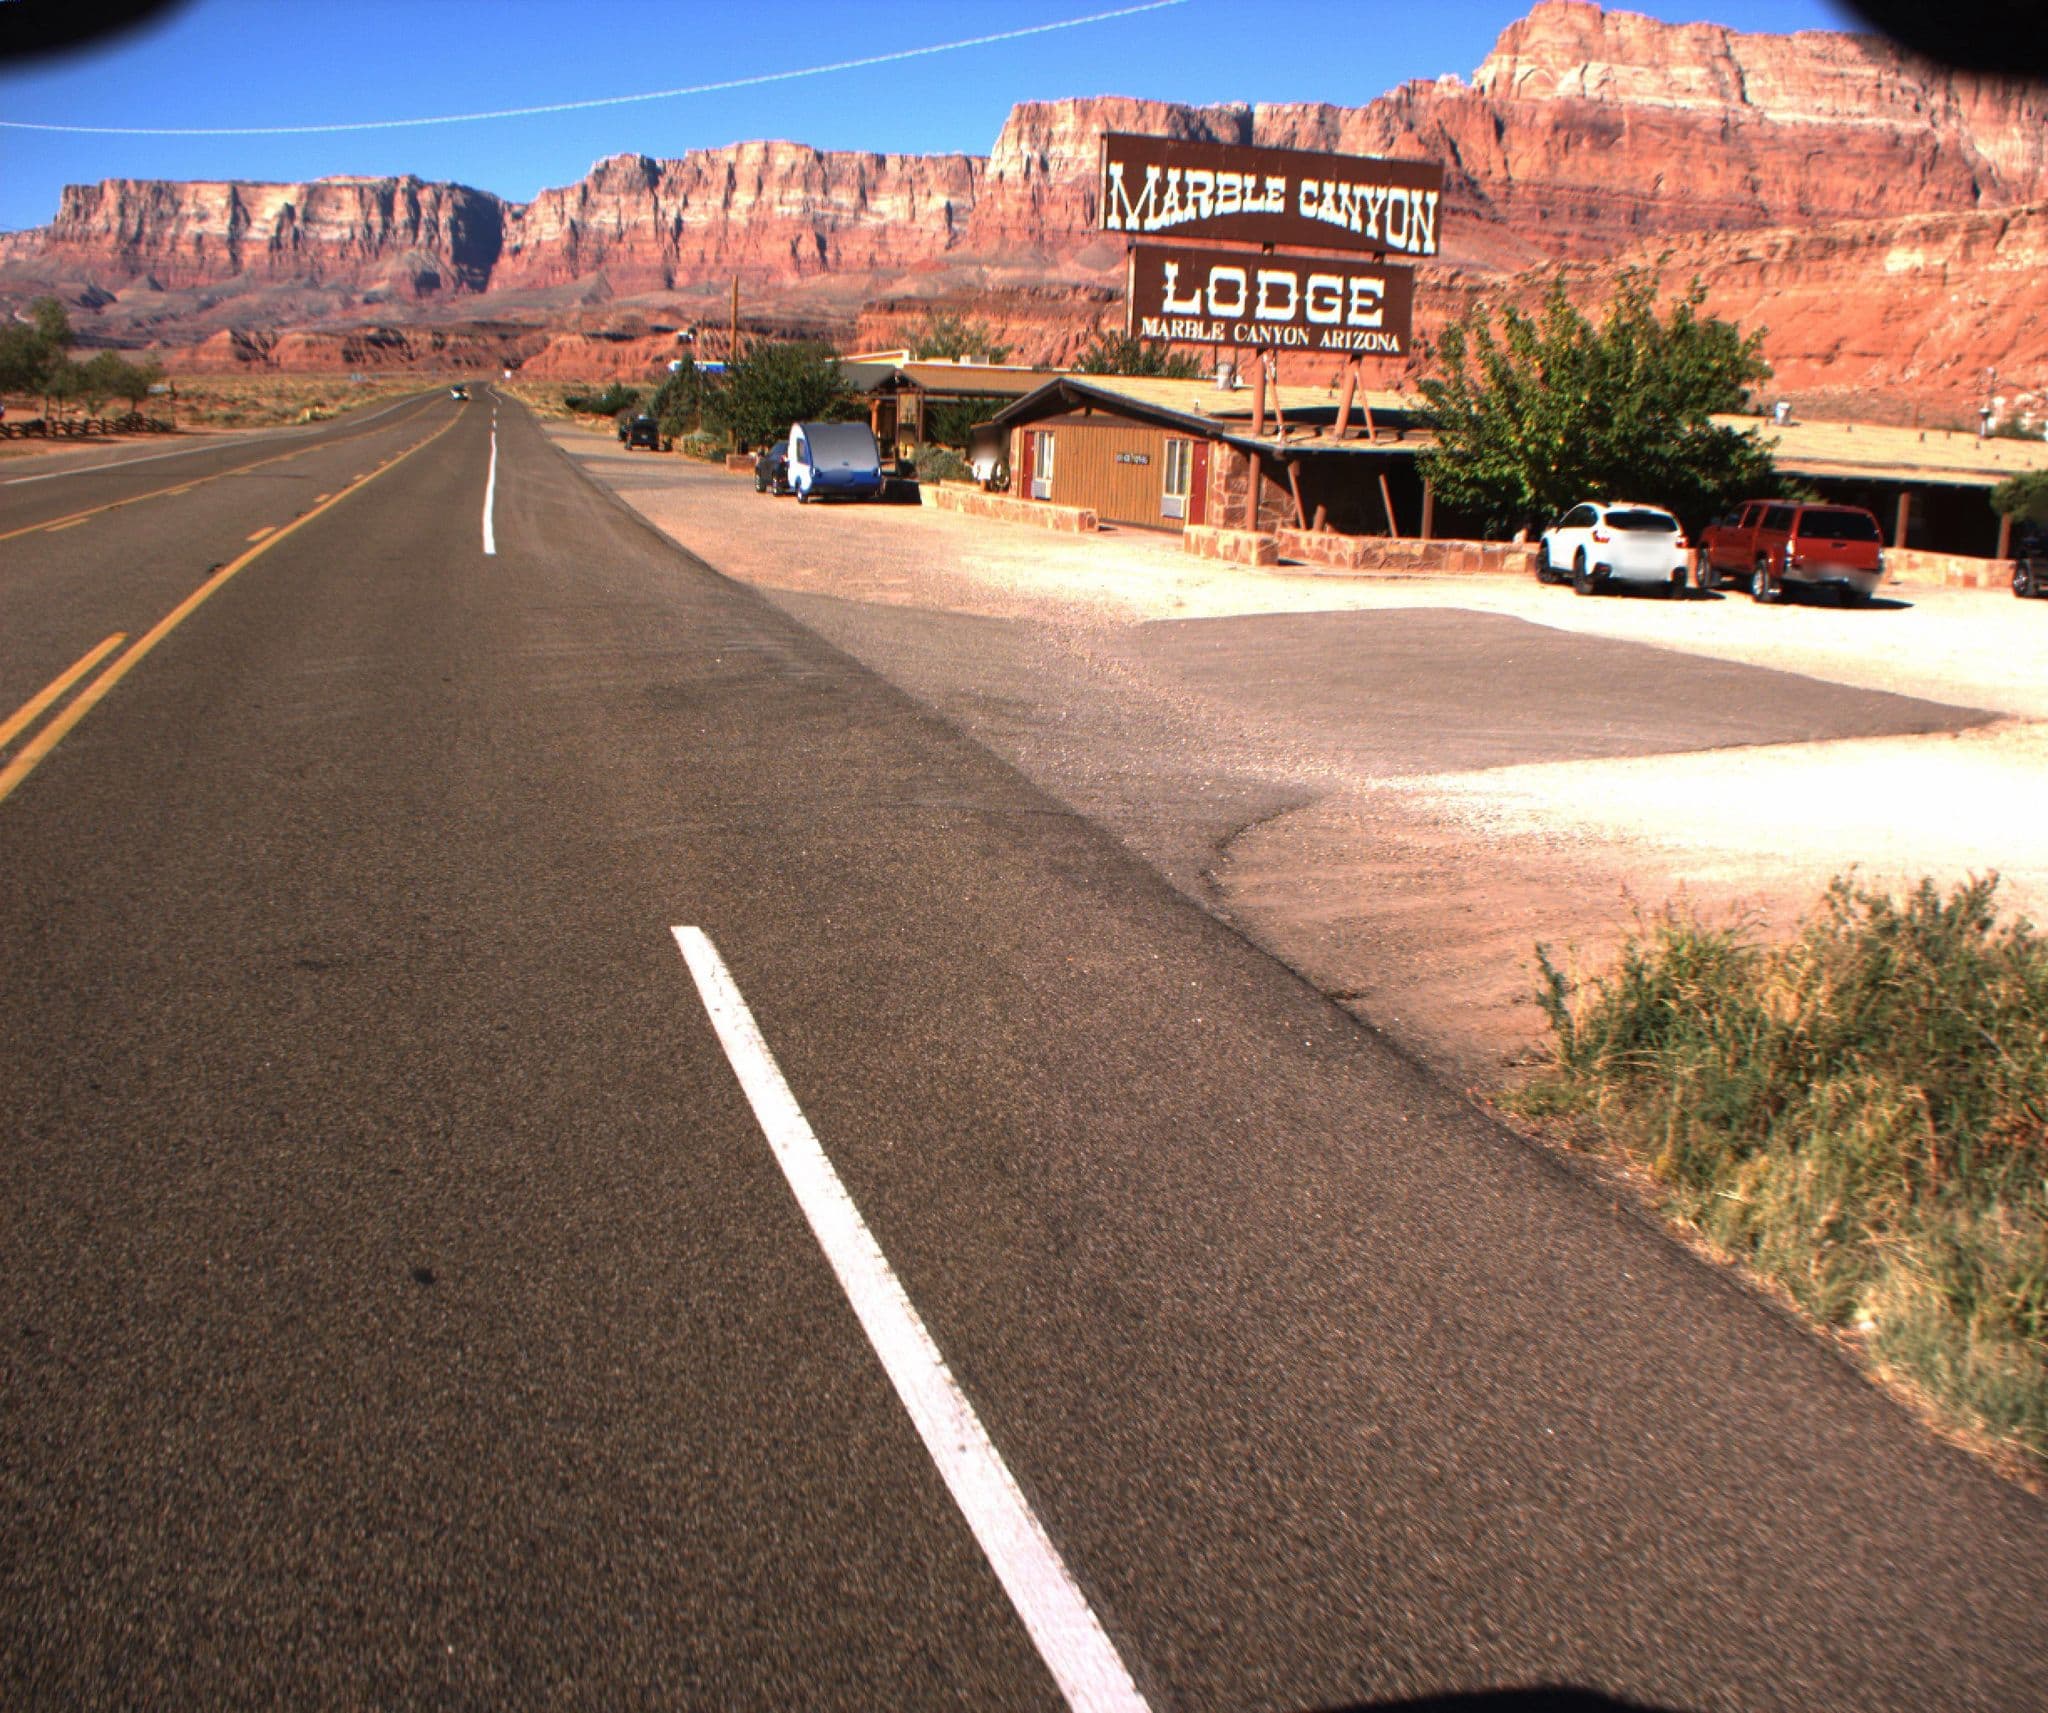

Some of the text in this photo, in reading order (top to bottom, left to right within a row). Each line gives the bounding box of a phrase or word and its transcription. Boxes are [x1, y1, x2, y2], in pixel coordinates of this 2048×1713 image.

[1108, 162, 1438, 253] MARBLE CANYON
[1162, 261, 1385, 327] LODGE
[1141, 317, 1400, 352] MARBLE CANYON ARIZONA
